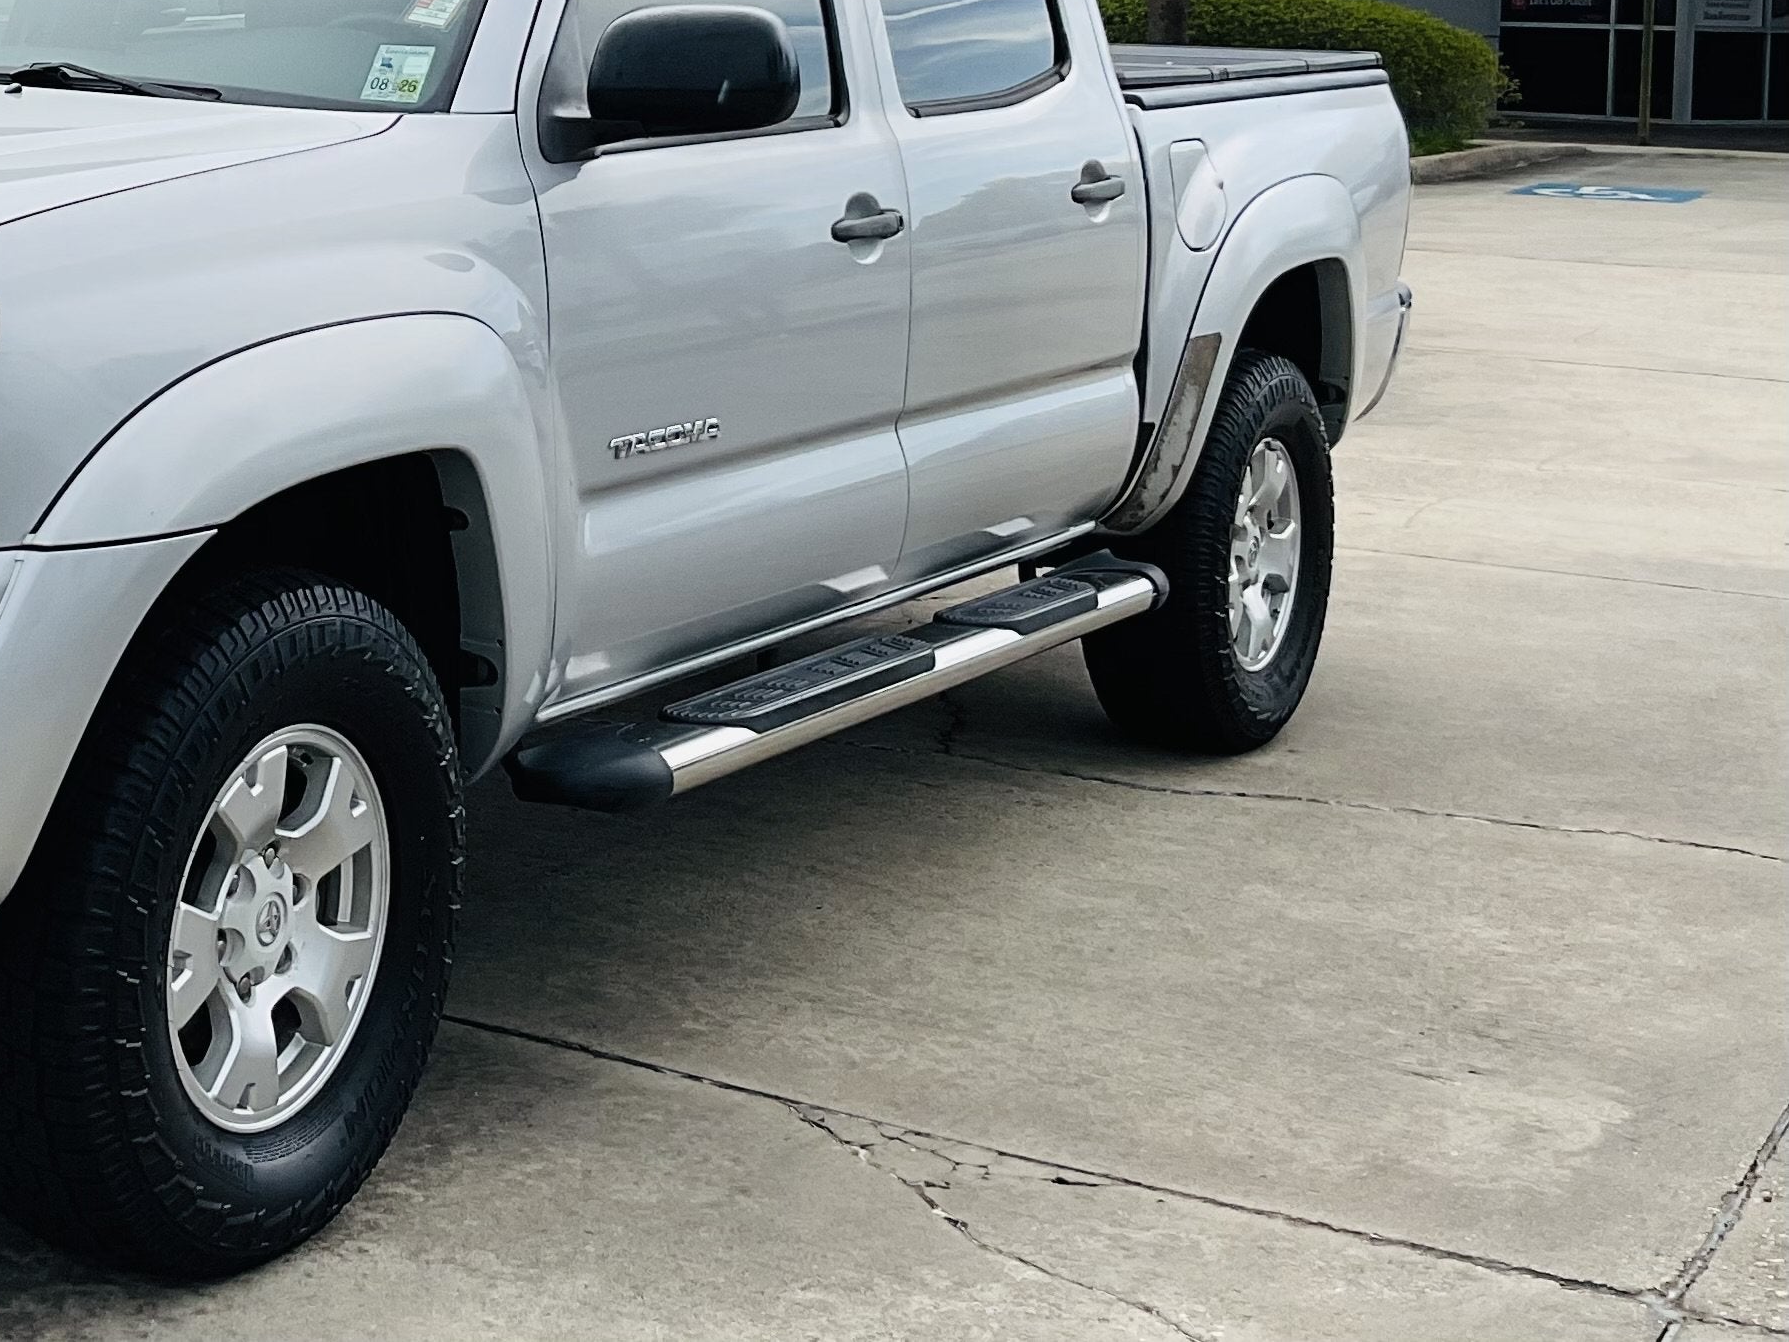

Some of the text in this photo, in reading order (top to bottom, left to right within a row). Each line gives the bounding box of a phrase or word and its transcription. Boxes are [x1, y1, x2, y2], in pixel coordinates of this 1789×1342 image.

[370, 77, 390, 91] 08
[398, 79, 419, 93] 26
[610, 417, 721, 460] TACOMA
